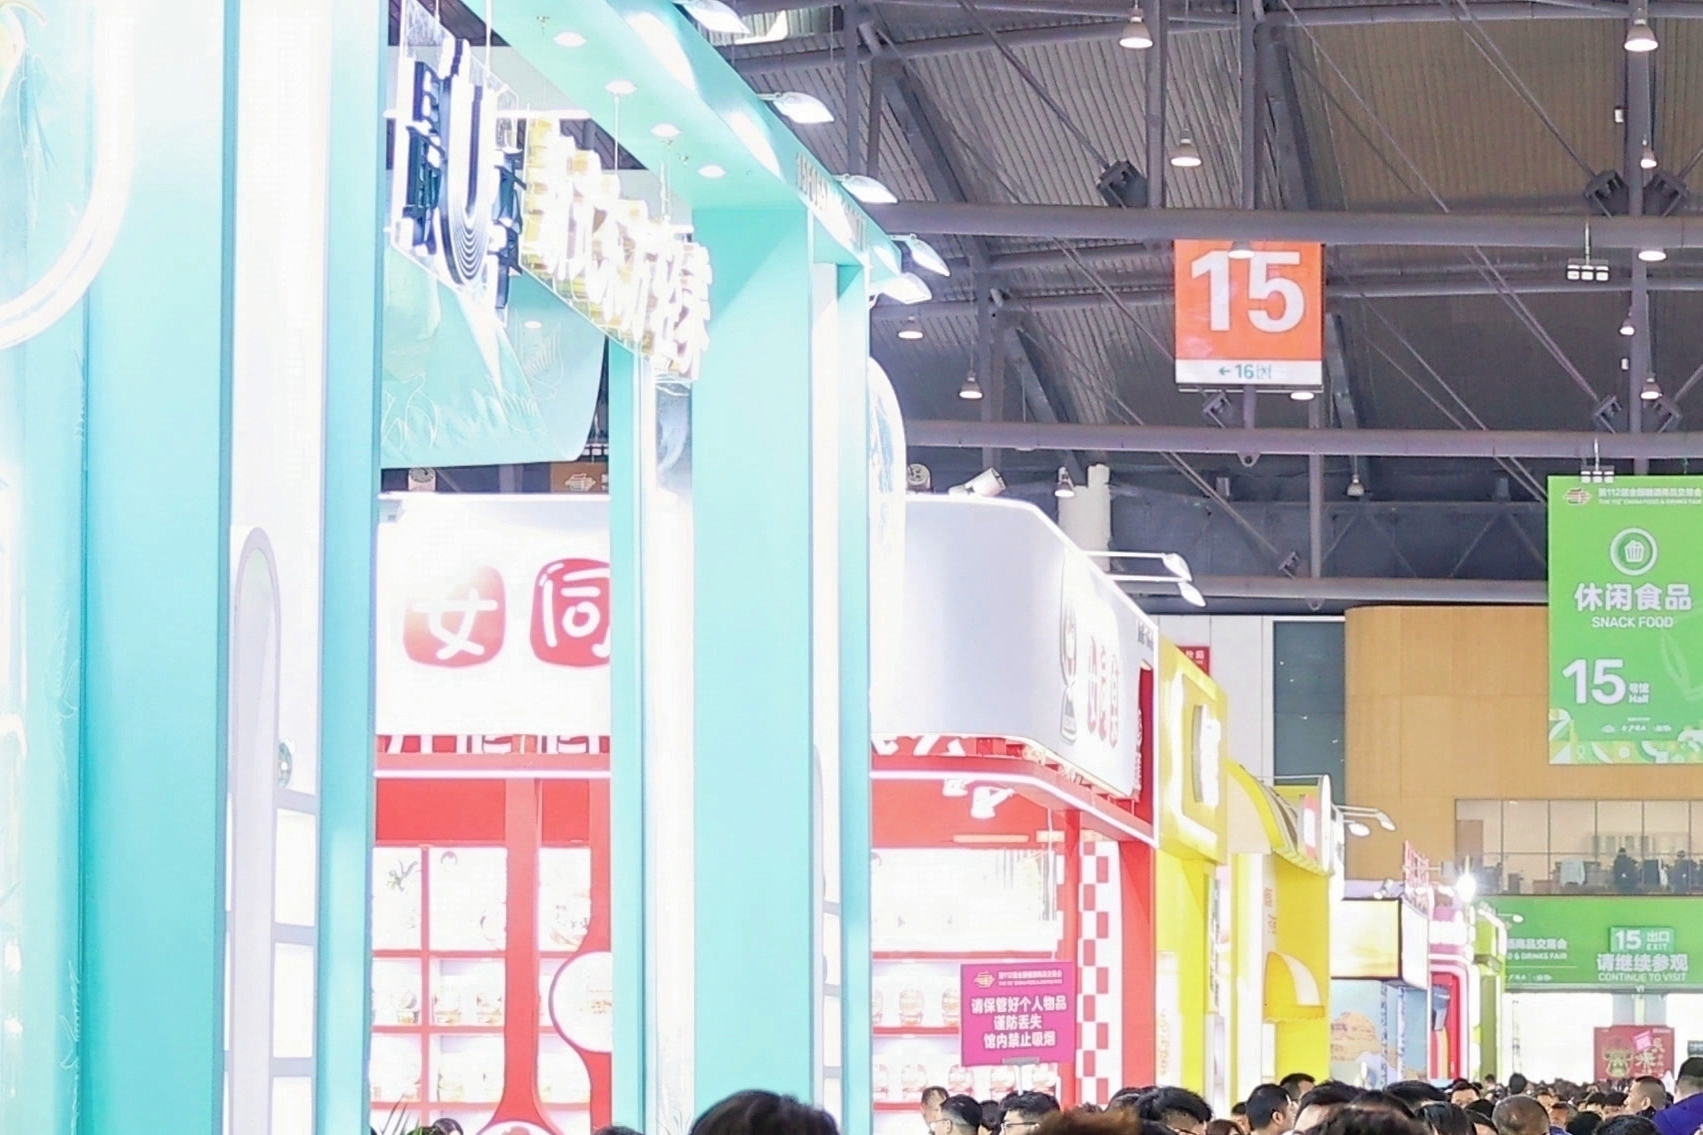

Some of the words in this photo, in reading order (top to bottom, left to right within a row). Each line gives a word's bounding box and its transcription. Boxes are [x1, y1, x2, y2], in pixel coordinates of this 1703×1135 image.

[1191, 250, 1305, 332] 15
[1574, 582, 1692, 612] 休闲食品
[1592, 616, 1636, 628] SNACK
[1638, 616, 1674, 628] FOOD
[1561, 658, 1626, 705] 15
[1615, 930, 1641, 951] 15
[1647, 931, 1669, 943] 出口
[1597, 953, 1689, 972] 请继续参观
[1598, 973, 1646, 982] CONTINUE
[1649, 973, 1662, 982] TO
[1664, 973, 1687, 982] VISIT
[971, 994, 1067, 1014] 请保管好个人物品
[994, 1013, 1042, 1031] 谨防丢失
[983, 1030, 1056, 1049] 馆内禁止吸烟
